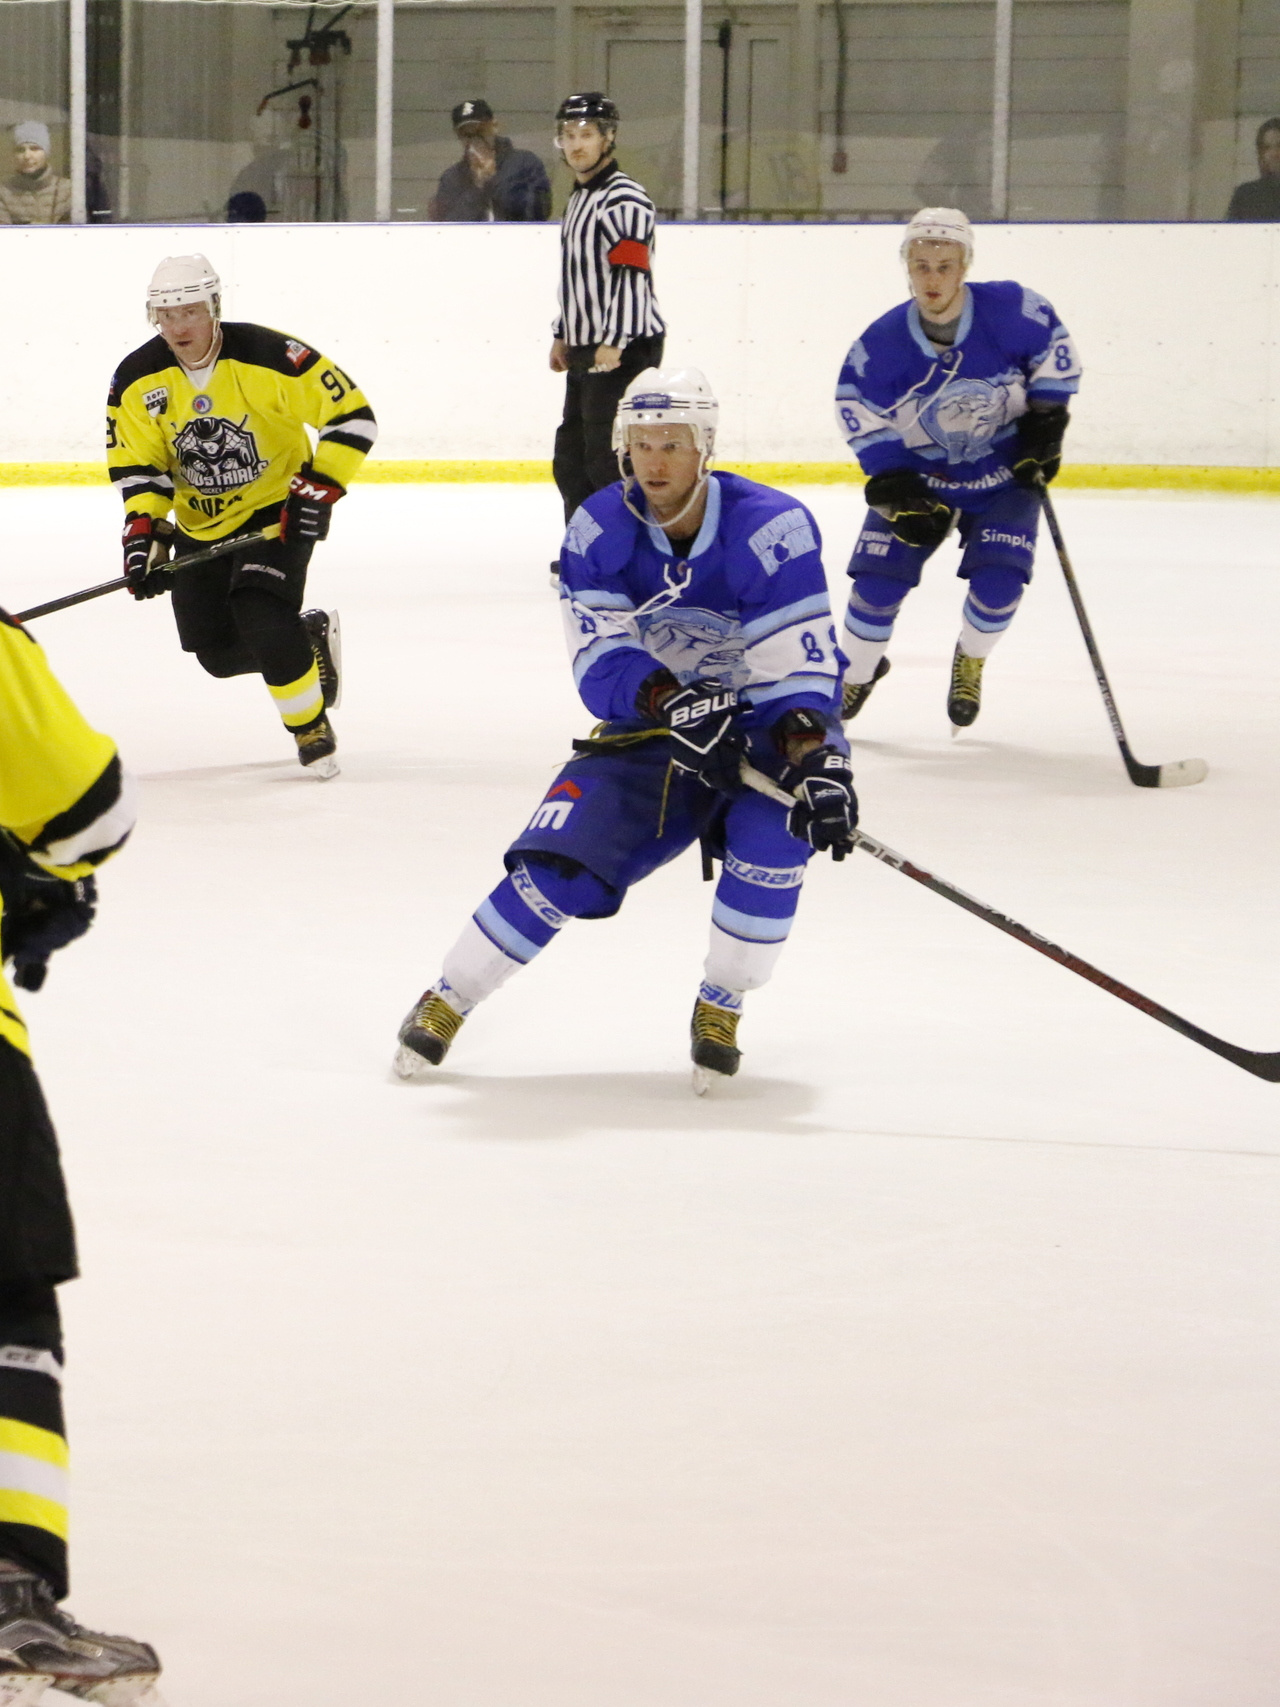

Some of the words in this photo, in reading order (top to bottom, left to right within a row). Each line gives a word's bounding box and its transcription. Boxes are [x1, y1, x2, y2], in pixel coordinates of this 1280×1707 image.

[1055, 344, 1071, 372] 8
[321, 365, 357, 402] 91
[841, 407, 860, 432] 8
